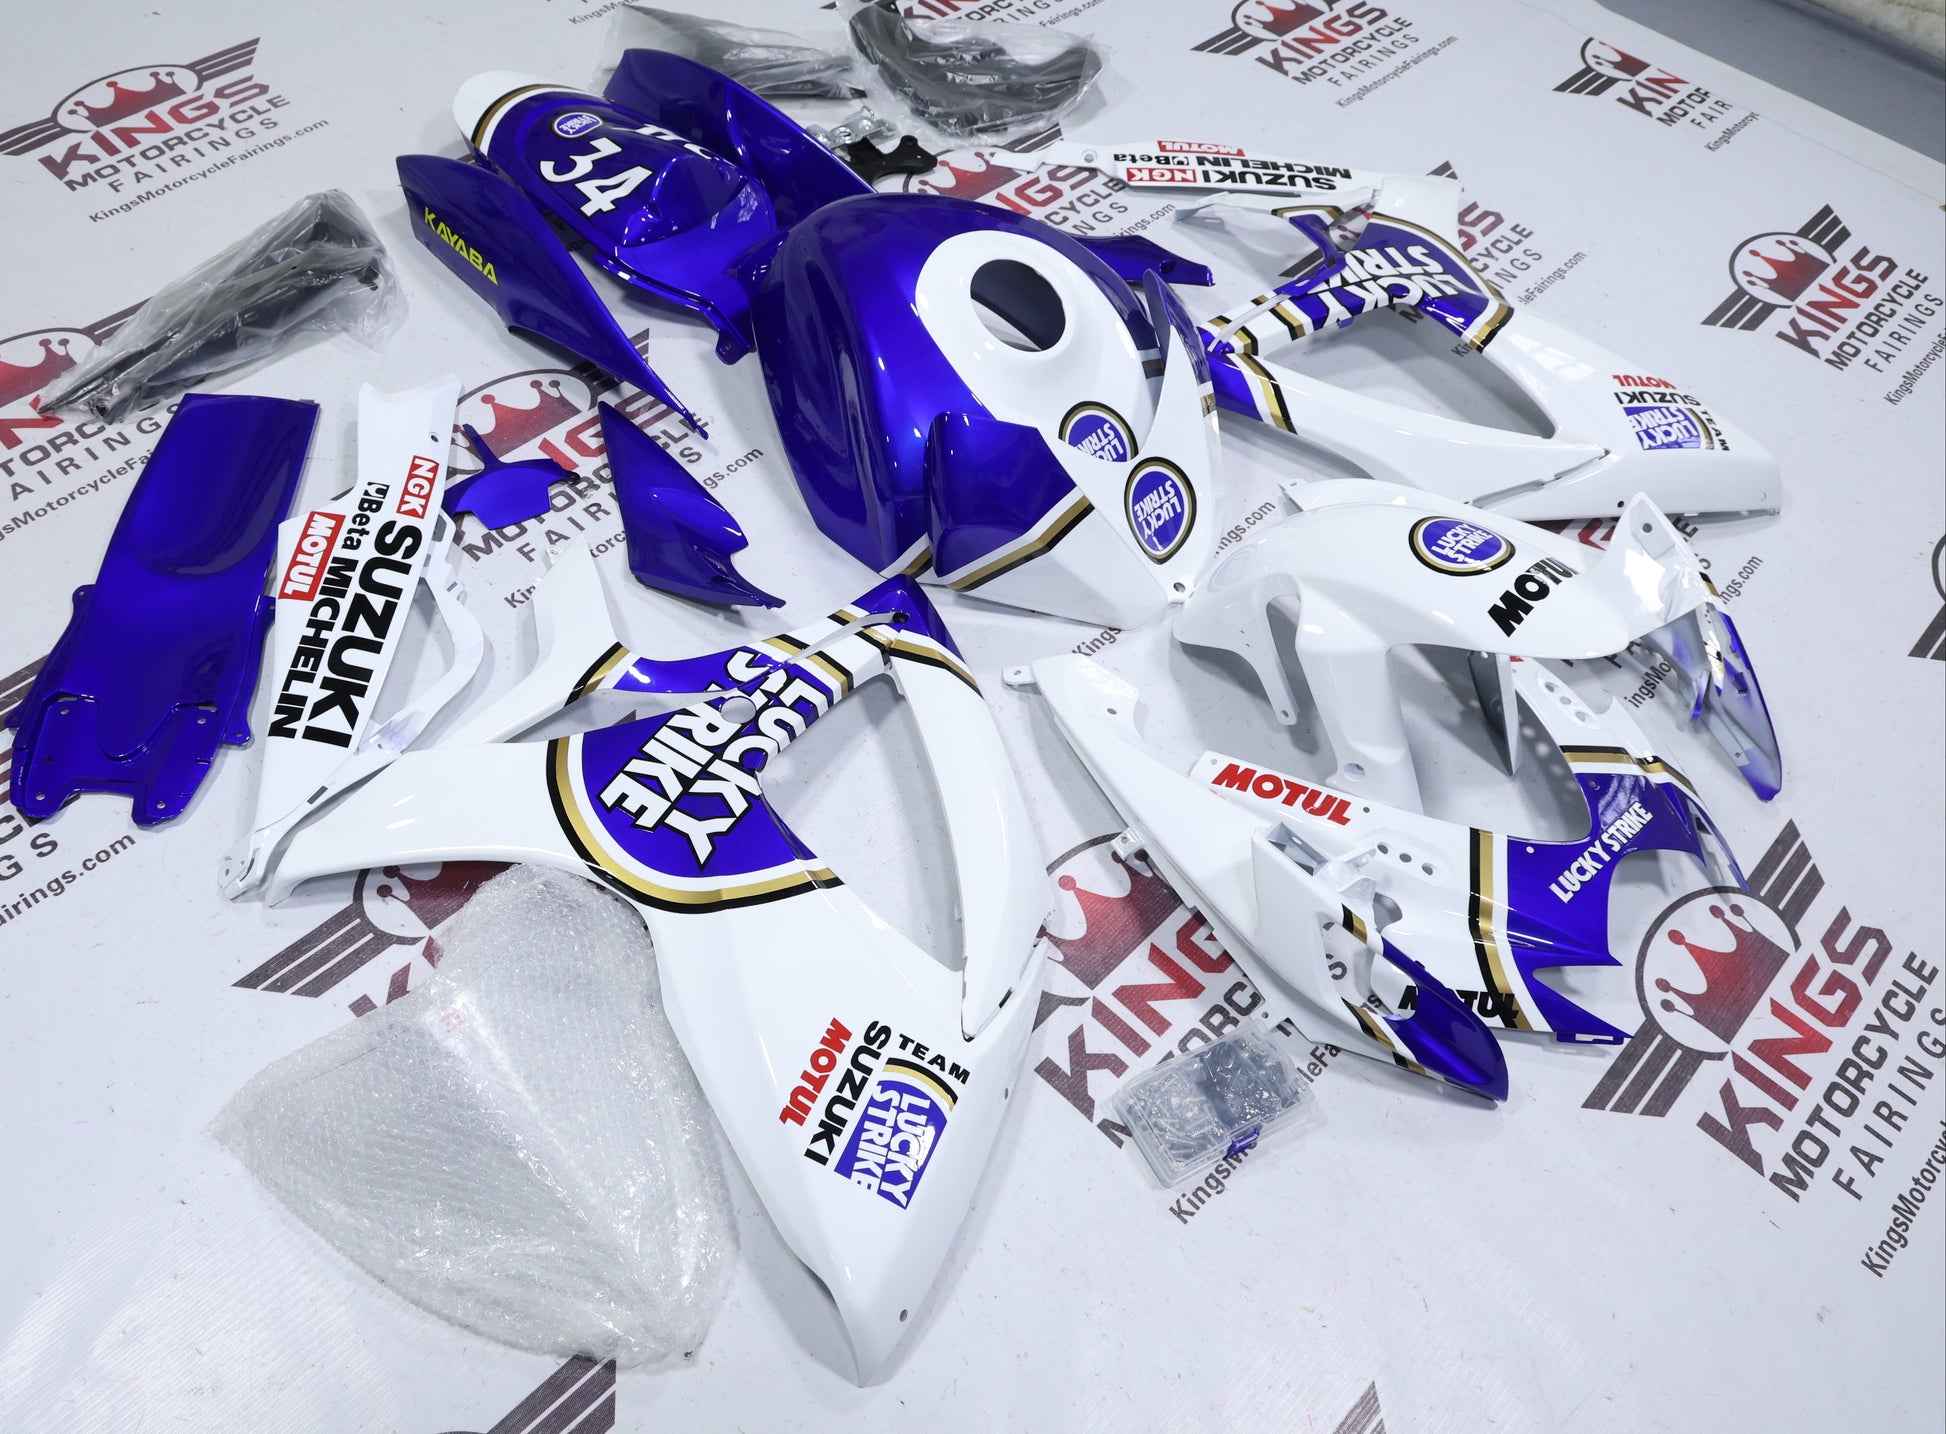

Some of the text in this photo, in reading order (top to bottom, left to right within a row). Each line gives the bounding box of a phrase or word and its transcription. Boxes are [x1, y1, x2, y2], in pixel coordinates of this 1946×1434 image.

[1255, 1, 1388, 77] KINGS
[1292, 16, 1413, 85] MOTORCYCLE
[1327, 33, 1420, 86] FAIRINGS
[1335, 34, 1459, 108] KingsMotorcycleFairings.com
[38, 73, 271, 182] KINGS
[63, 94, 290, 192] MOTORCYCLE
[1162, 140, 1240, 156] MOTUL
[1690, 100, 1734, 129] FAIR
[89, 118, 330, 223] KingsMotorcycleFairings.com
[108, 117, 281, 193] FAIRINGS
[540, 137, 653, 218] 34
[1113, 153, 1353, 180] MICHELIN Beta
[1130, 167, 1337, 191] SUZUKI NGK
[424, 206, 499, 287] KAYABA
[1775, 245, 1898, 360] KINGS
[1824, 267, 1929, 371] MOTORCYCLE
[1864, 293, 1944, 373] FAIRINGS
[1612, 374, 1677, 390] MOTUL
[1613, 390, 1702, 406] SUZUKI
[1638, 419, 1699, 450] LUCKY
[1700, 409, 1730, 451] TEAM
[1133, 479, 1176, 523] STRIKE
[1141, 495, 1182, 541] LUCKY
[1431, 523, 1477, 556] LUCKY
[284, 513, 336, 598] MOTUL
[1448, 530, 1494, 563] STRIKE
[267, 497, 384, 739] Beta MICHELIN
[302, 456, 437, 749] NGK SUZUKI
[663, 677, 830, 867] LUCKY
[1211, 762, 1352, 826] MOTUL
[1550, 801, 1654, 904] LUCKY STRIKE
[778, 1017, 853, 1127] MOTUL
[898, 1033, 971, 1085] TEAM
[1696, 905, 1893, 1177] KINGS
[1769, 951, 1940, 1203] MOTORCYCLE
[803, 1020, 892, 1166] SUZUKI
[1831, 1007, 1946, 1202] FAIRINGS
[851, 1084, 899, 1192] STRIKE
[879, 1093, 936, 1209] LUCKY
